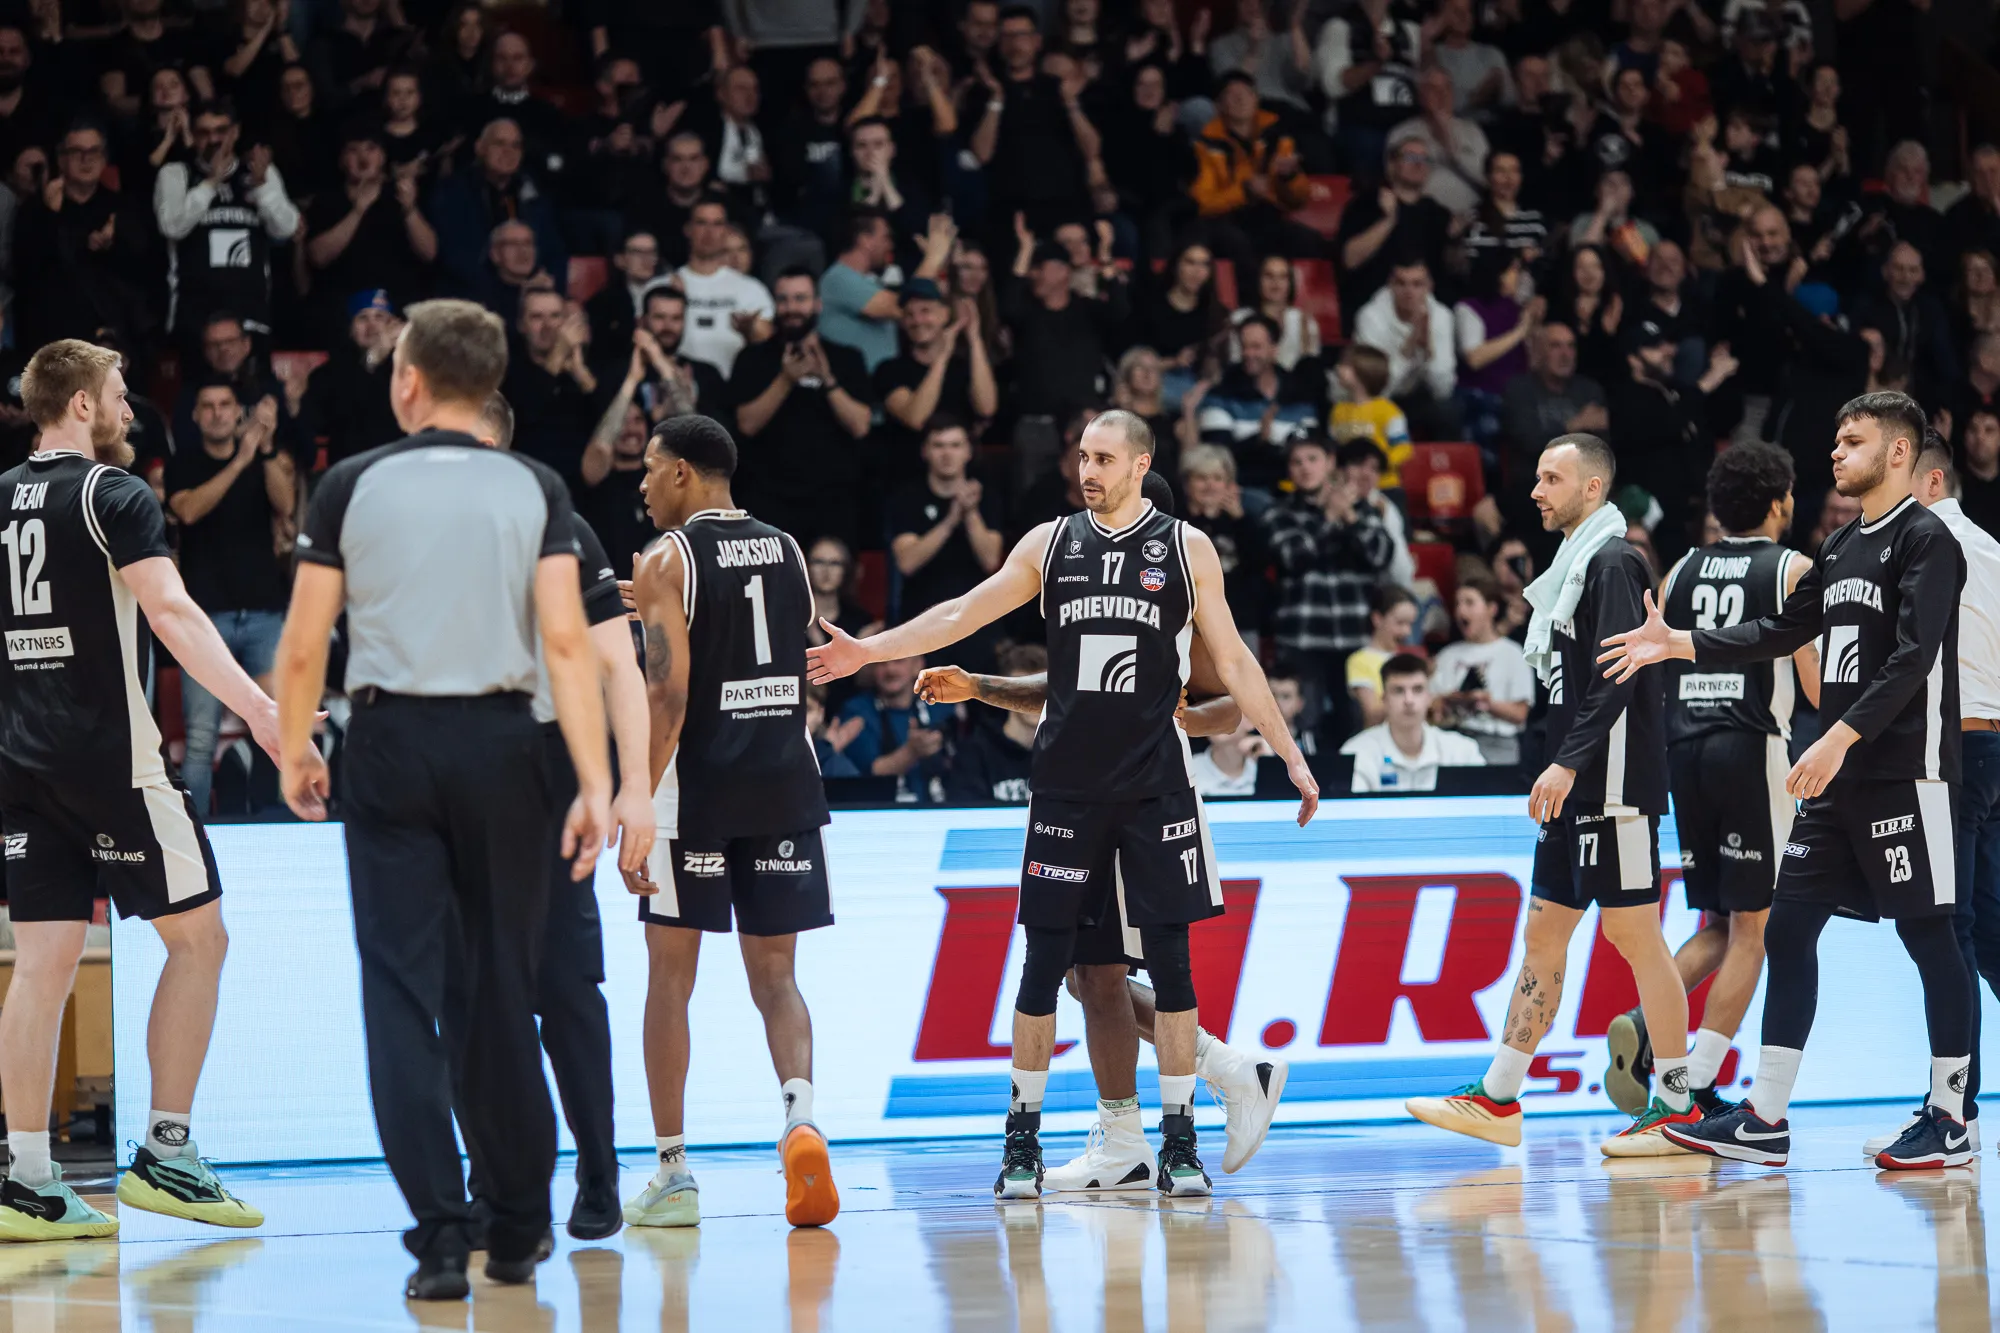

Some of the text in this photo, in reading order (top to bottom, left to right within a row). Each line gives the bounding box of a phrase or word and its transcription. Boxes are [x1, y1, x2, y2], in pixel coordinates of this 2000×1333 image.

[11, 481, 49, 511] DEAN
[0, 518, 52, 616] 12
[716, 536, 785, 569] JACKSON
[1101, 551, 1126, 585] 17
[1699, 556, 1751, 580] LOVING
[1058, 575, 1090, 583] PARTNERS
[1143, 577, 1162, 586] SBL
[1823, 577, 1884, 615] PRIEVIDZA
[744, 575, 772, 666] 1
[1059, 595, 1161, 631] PRIEVIDZA
[1692, 584, 1745, 631] 32
[725, 684, 795, 703] PARTNERS
[1043, 825, 1075, 839] ATTIS
[1179, 846, 1198, 885] 17
[1579, 832, 1598, 867] 77
[1885, 845, 1913, 884] 23
[1043, 866, 1086, 881] TIPOS
